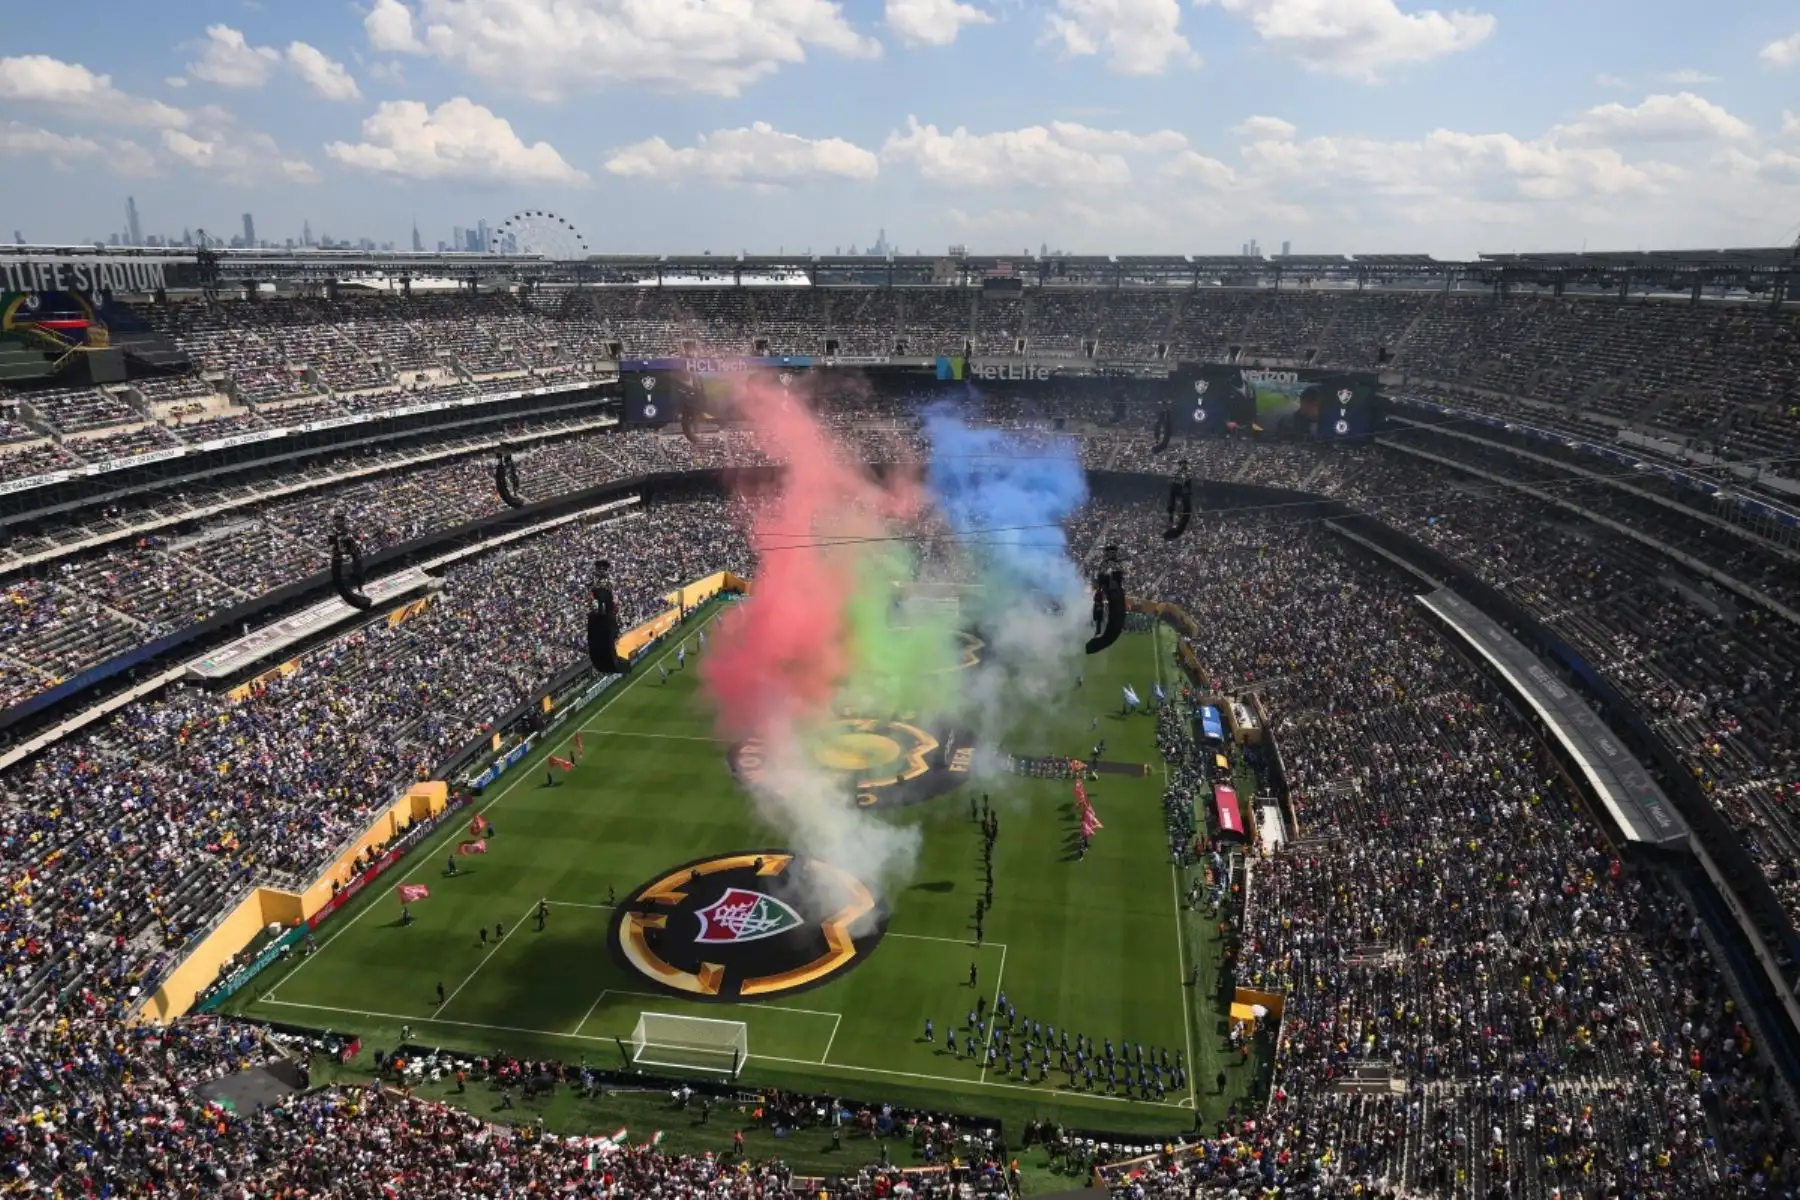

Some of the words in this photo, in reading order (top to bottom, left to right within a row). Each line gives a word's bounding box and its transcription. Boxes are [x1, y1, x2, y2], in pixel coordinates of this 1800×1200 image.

[0, 262, 69, 292] TLIFE
[73, 262, 166, 291] STADIUM
[686, 358, 748, 373] HCLTech
[970, 360, 1049, 381] MetLife
[1240, 368, 1298, 384] verizon
[948, 747, 976, 772] FIFA
